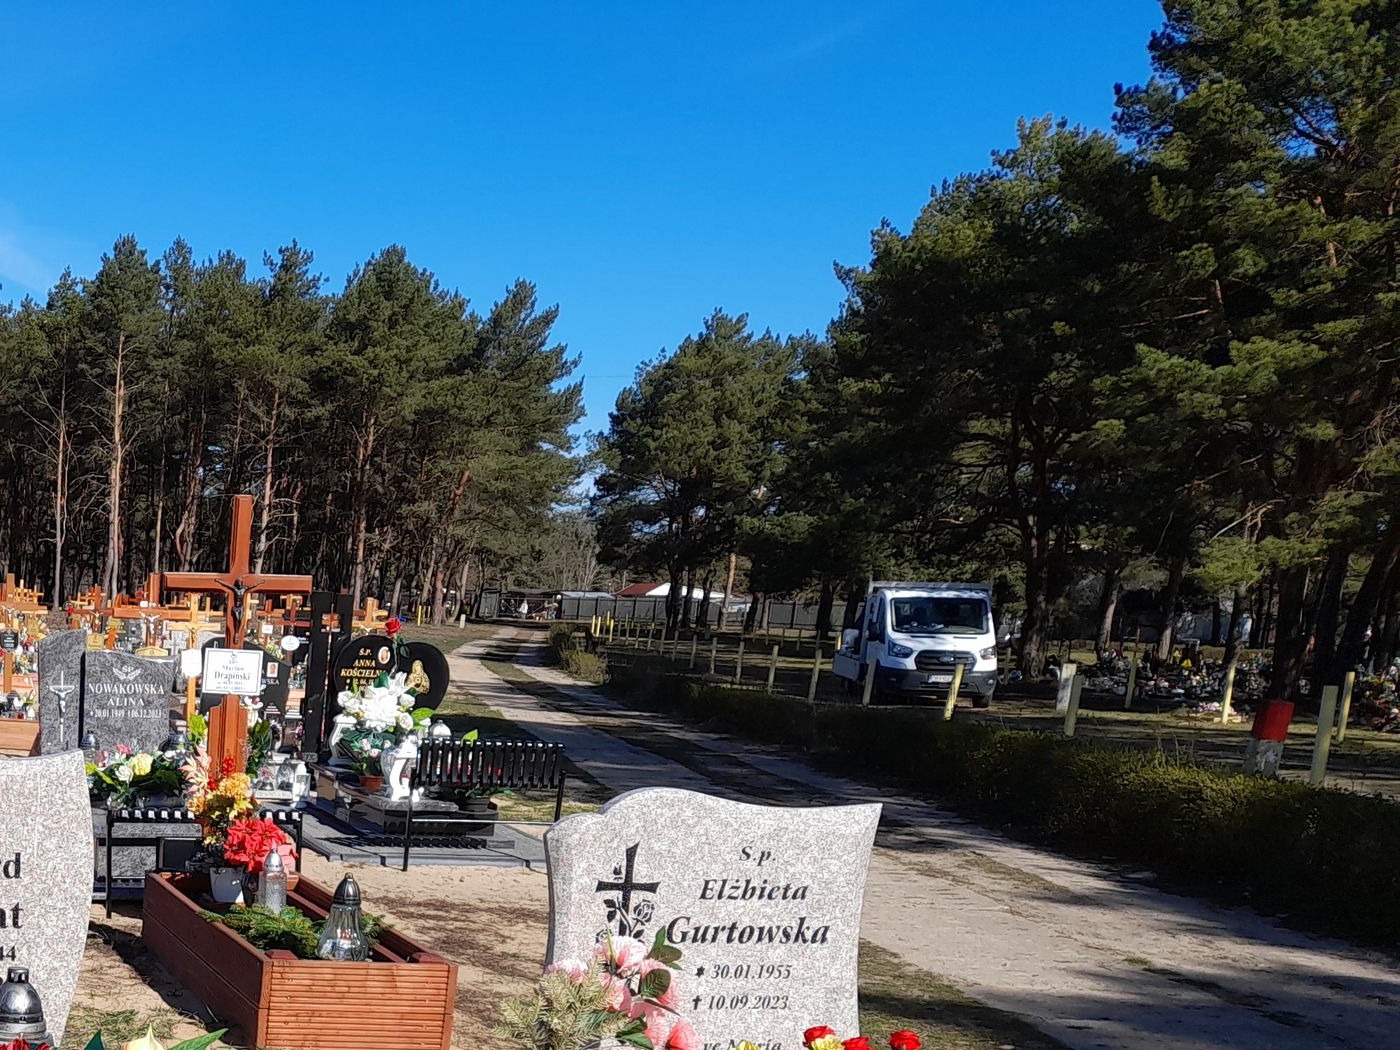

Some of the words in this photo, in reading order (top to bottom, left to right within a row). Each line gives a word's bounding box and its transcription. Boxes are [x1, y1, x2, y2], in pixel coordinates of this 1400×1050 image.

[352, 659, 376, 667] ANNA
[340, 667, 387, 678] KOŚCIELN
[88, 682, 165, 695] NOWAKOWSKA
[107, 697, 145, 706] ALINA
[699, 878, 810, 901] Elżbieta
[666, 915, 831, 945] Gurtowska
[710, 964, 793, 980] 30.01.1955
[707, 995, 789, 1010] 10.09.2023
